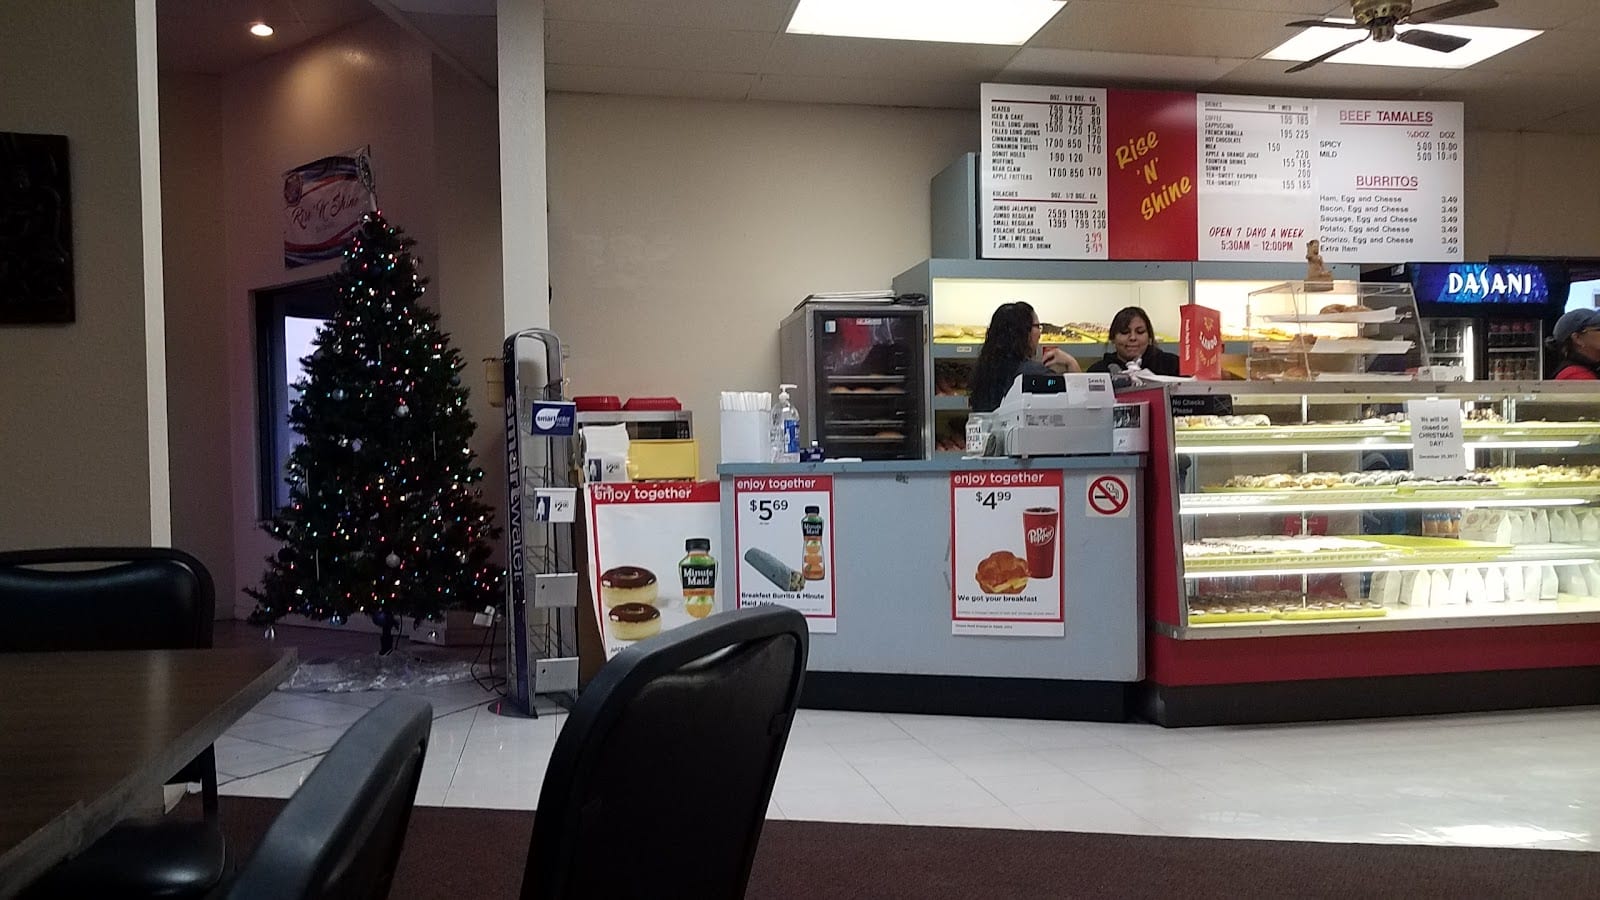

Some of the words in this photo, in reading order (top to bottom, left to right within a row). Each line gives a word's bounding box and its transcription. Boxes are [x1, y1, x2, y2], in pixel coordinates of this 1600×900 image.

[1340, 110, 1371, 121] BEEF
[1377, 111, 1433, 122] TAMALES
[1115, 131, 1158, 169] Rise
[1049, 167, 1066, 177] 1700
[1356, 176, 1418, 187] BURRITOS
[1141, 176, 1192, 220] Shine
[1341, 195, 1355, 203] Egg
[1348, 205, 1362, 213] Egg
[1209, 227, 1232, 237] OPEN
[1237, 228, 1242, 237] 7
[1247, 228, 1267, 238] DAYS
[1271, 228, 1276, 238] A
[1280, 228, 1305, 238] WEEK
[1221, 240, 1250, 250] 5:30AM
[1262, 241, 1294, 250] 12:00PM
[1353, 236, 1367, 244] Egg
[1449, 267, 1531, 299] DASANI
[954, 472, 987, 486] enjoy
[990, 471, 1044, 485] together
[737, 478, 766, 491] enjoy
[769, 478, 816, 490] together
[595, 486, 630, 502] enjoy
[634, 486, 692, 501] together
[683, 567, 714, 578] Minute
[688, 577, 711, 586] Maid
[1004, 594, 1038, 602] breakfast
